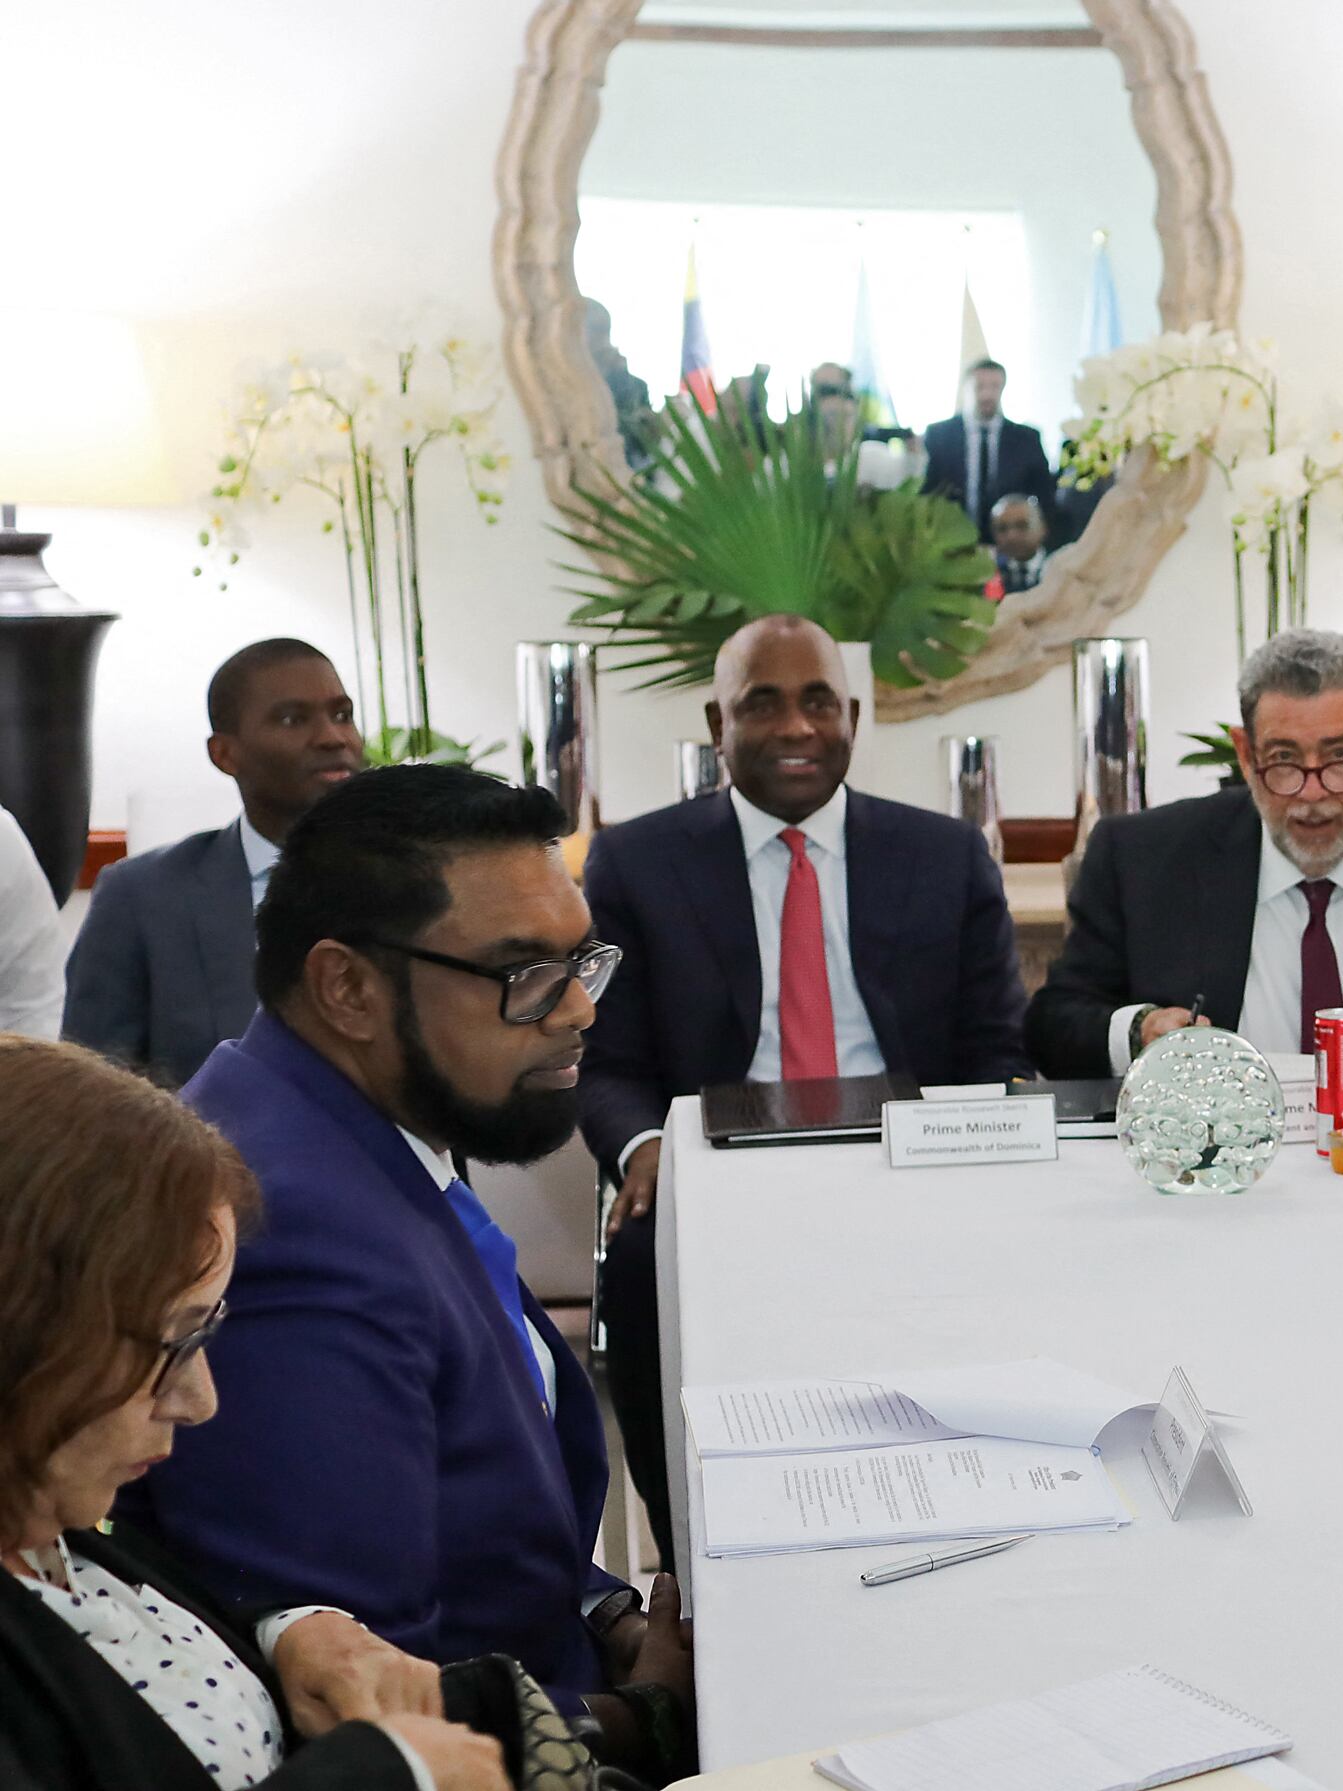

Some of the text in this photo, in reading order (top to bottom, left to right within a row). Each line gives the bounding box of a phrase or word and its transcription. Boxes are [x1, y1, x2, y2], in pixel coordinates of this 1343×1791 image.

[923, 1121, 1022, 1136] Prime Minister
[906, 1141, 1041, 1155] Commonwealth of Dominica
